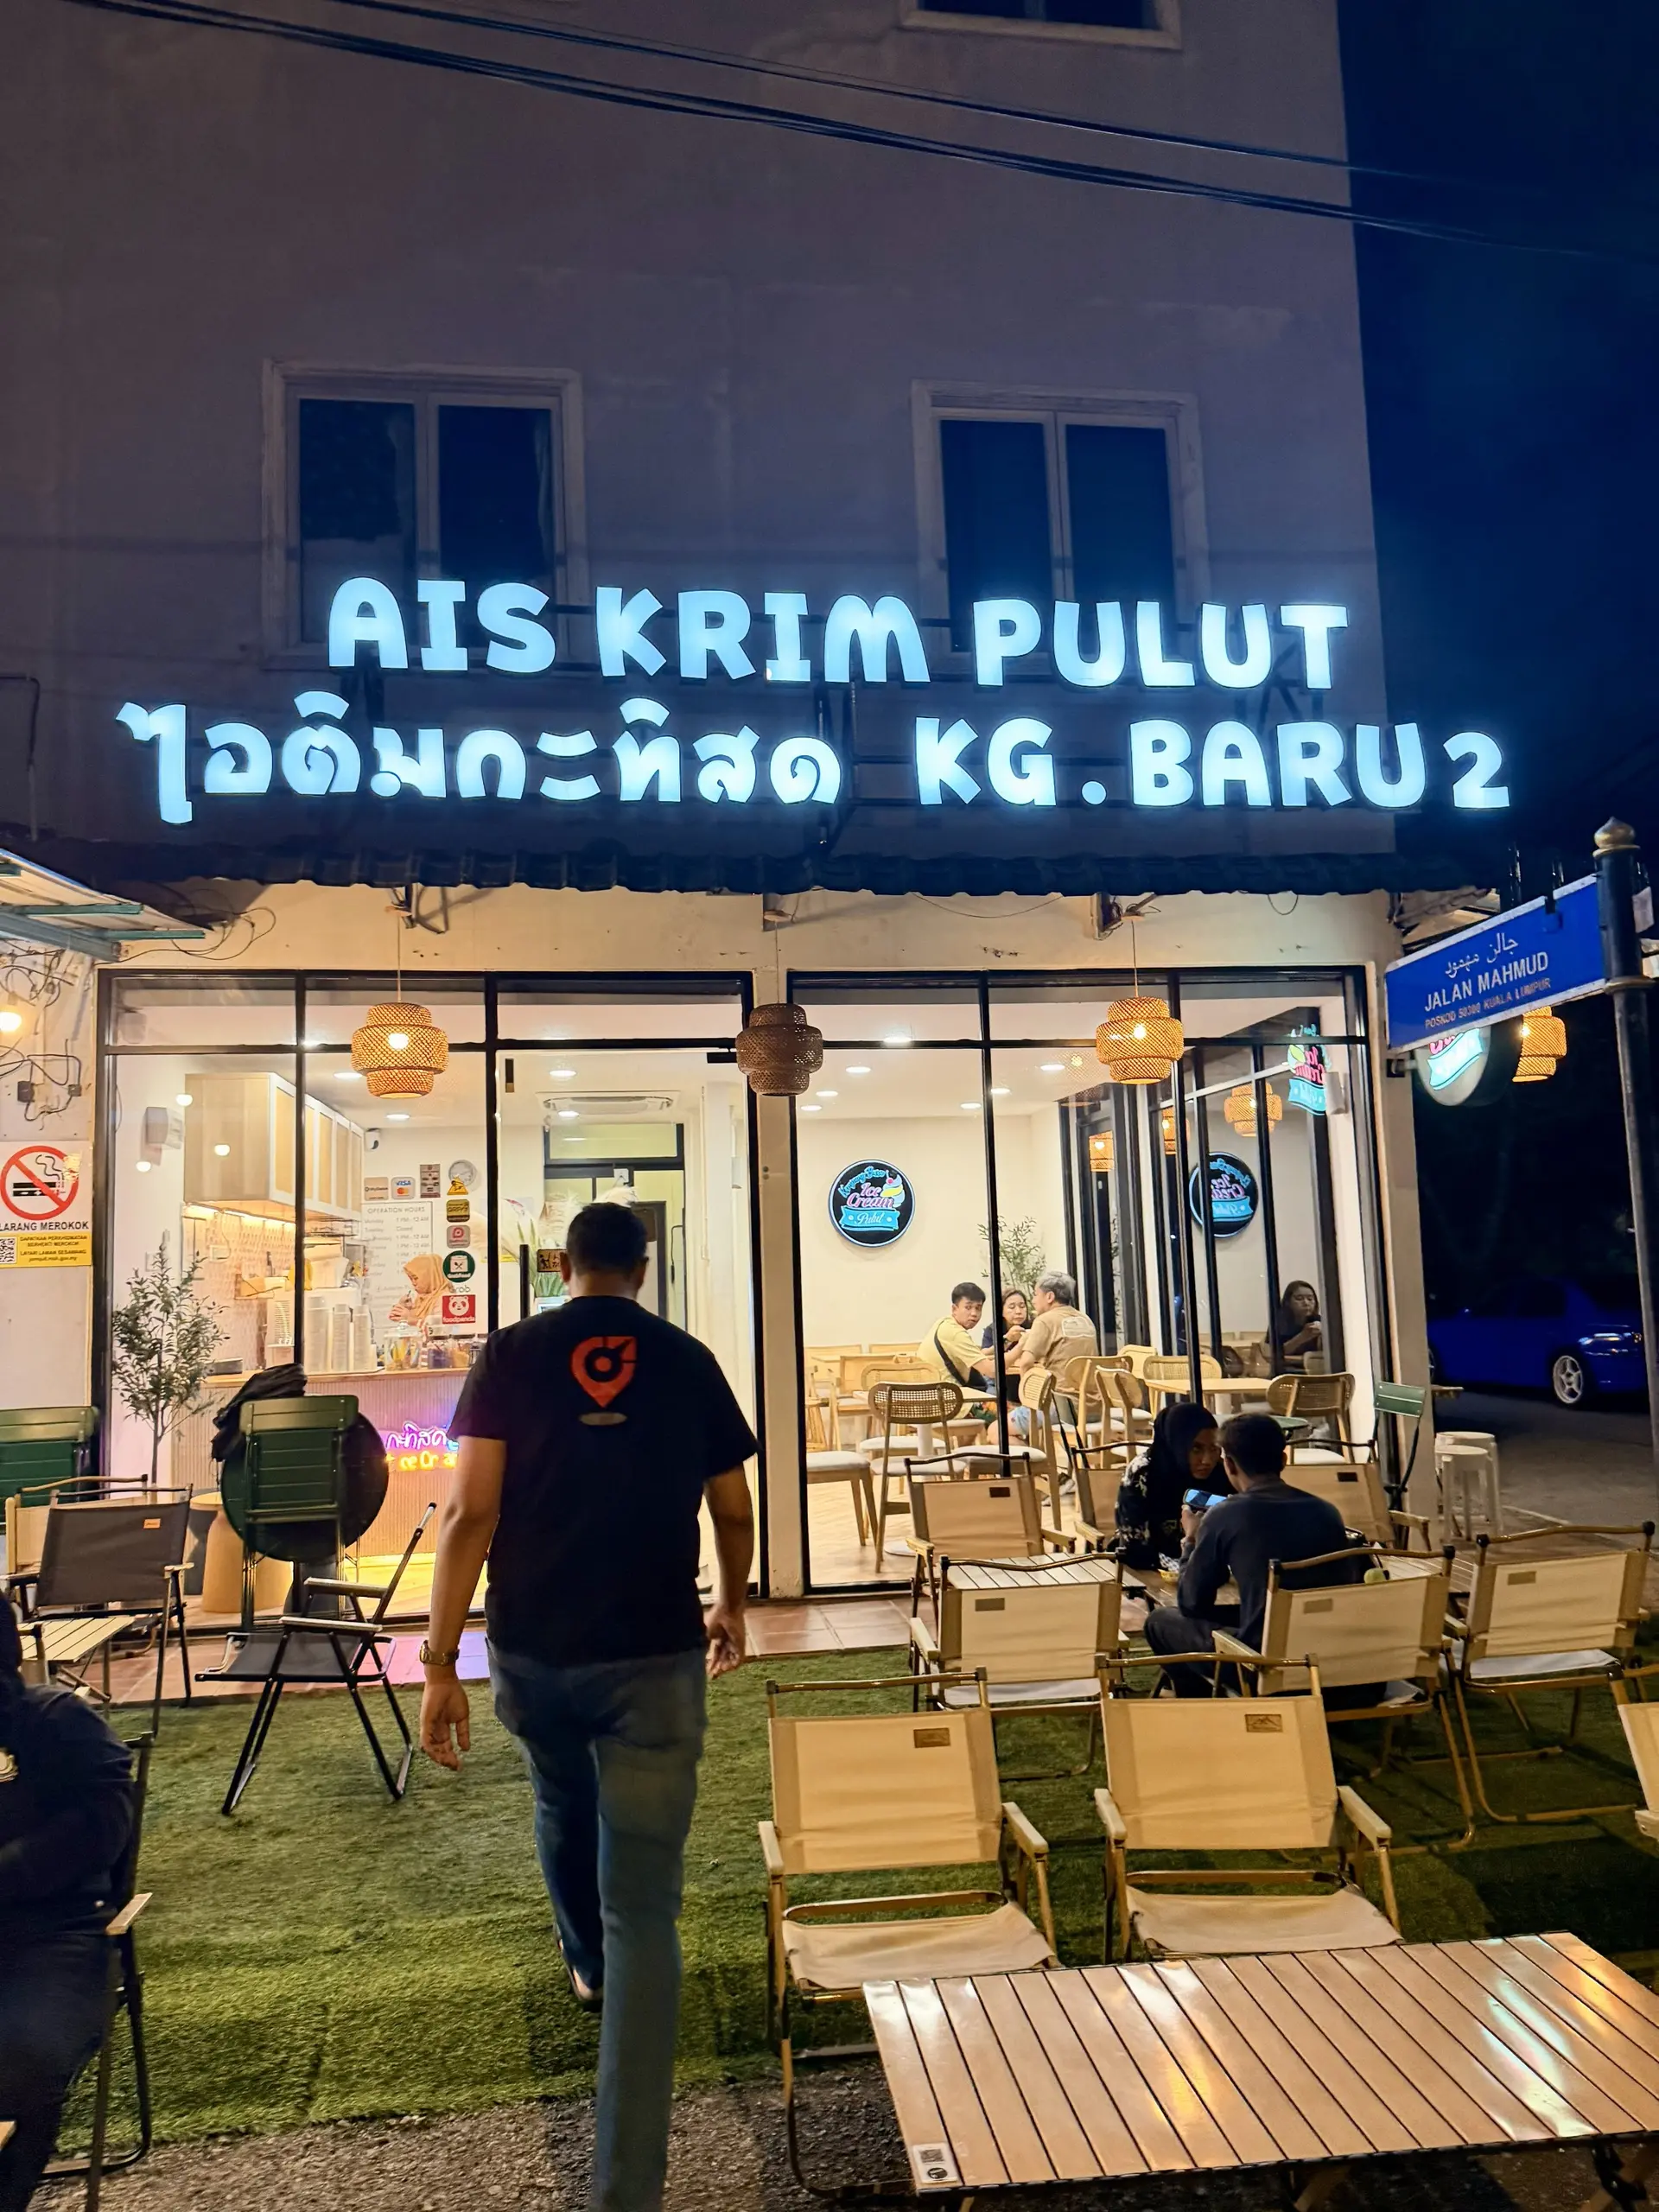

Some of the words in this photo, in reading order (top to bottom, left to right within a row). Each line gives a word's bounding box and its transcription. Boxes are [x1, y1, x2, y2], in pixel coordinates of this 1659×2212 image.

[328, 577, 556, 672] AIS
[596, 587, 931, 683] KRIM
[973, 599, 1348, 689] PULUT
[116, 691, 842, 824] ไอติมกะทิสด
[1129, 720, 1427, 809] BARU
[1443, 732, 1510, 809] 2
[1425, 979, 1472, 1012] JALAN
[1478, 951, 1548, 994] MAHMUD
[847, 1192, 893, 1208] Cream
[861, 1182, 882, 1197] Ice
[40, 1221, 89, 1230] MEROKOK
[855, 1212, 886, 1224] Pulut
